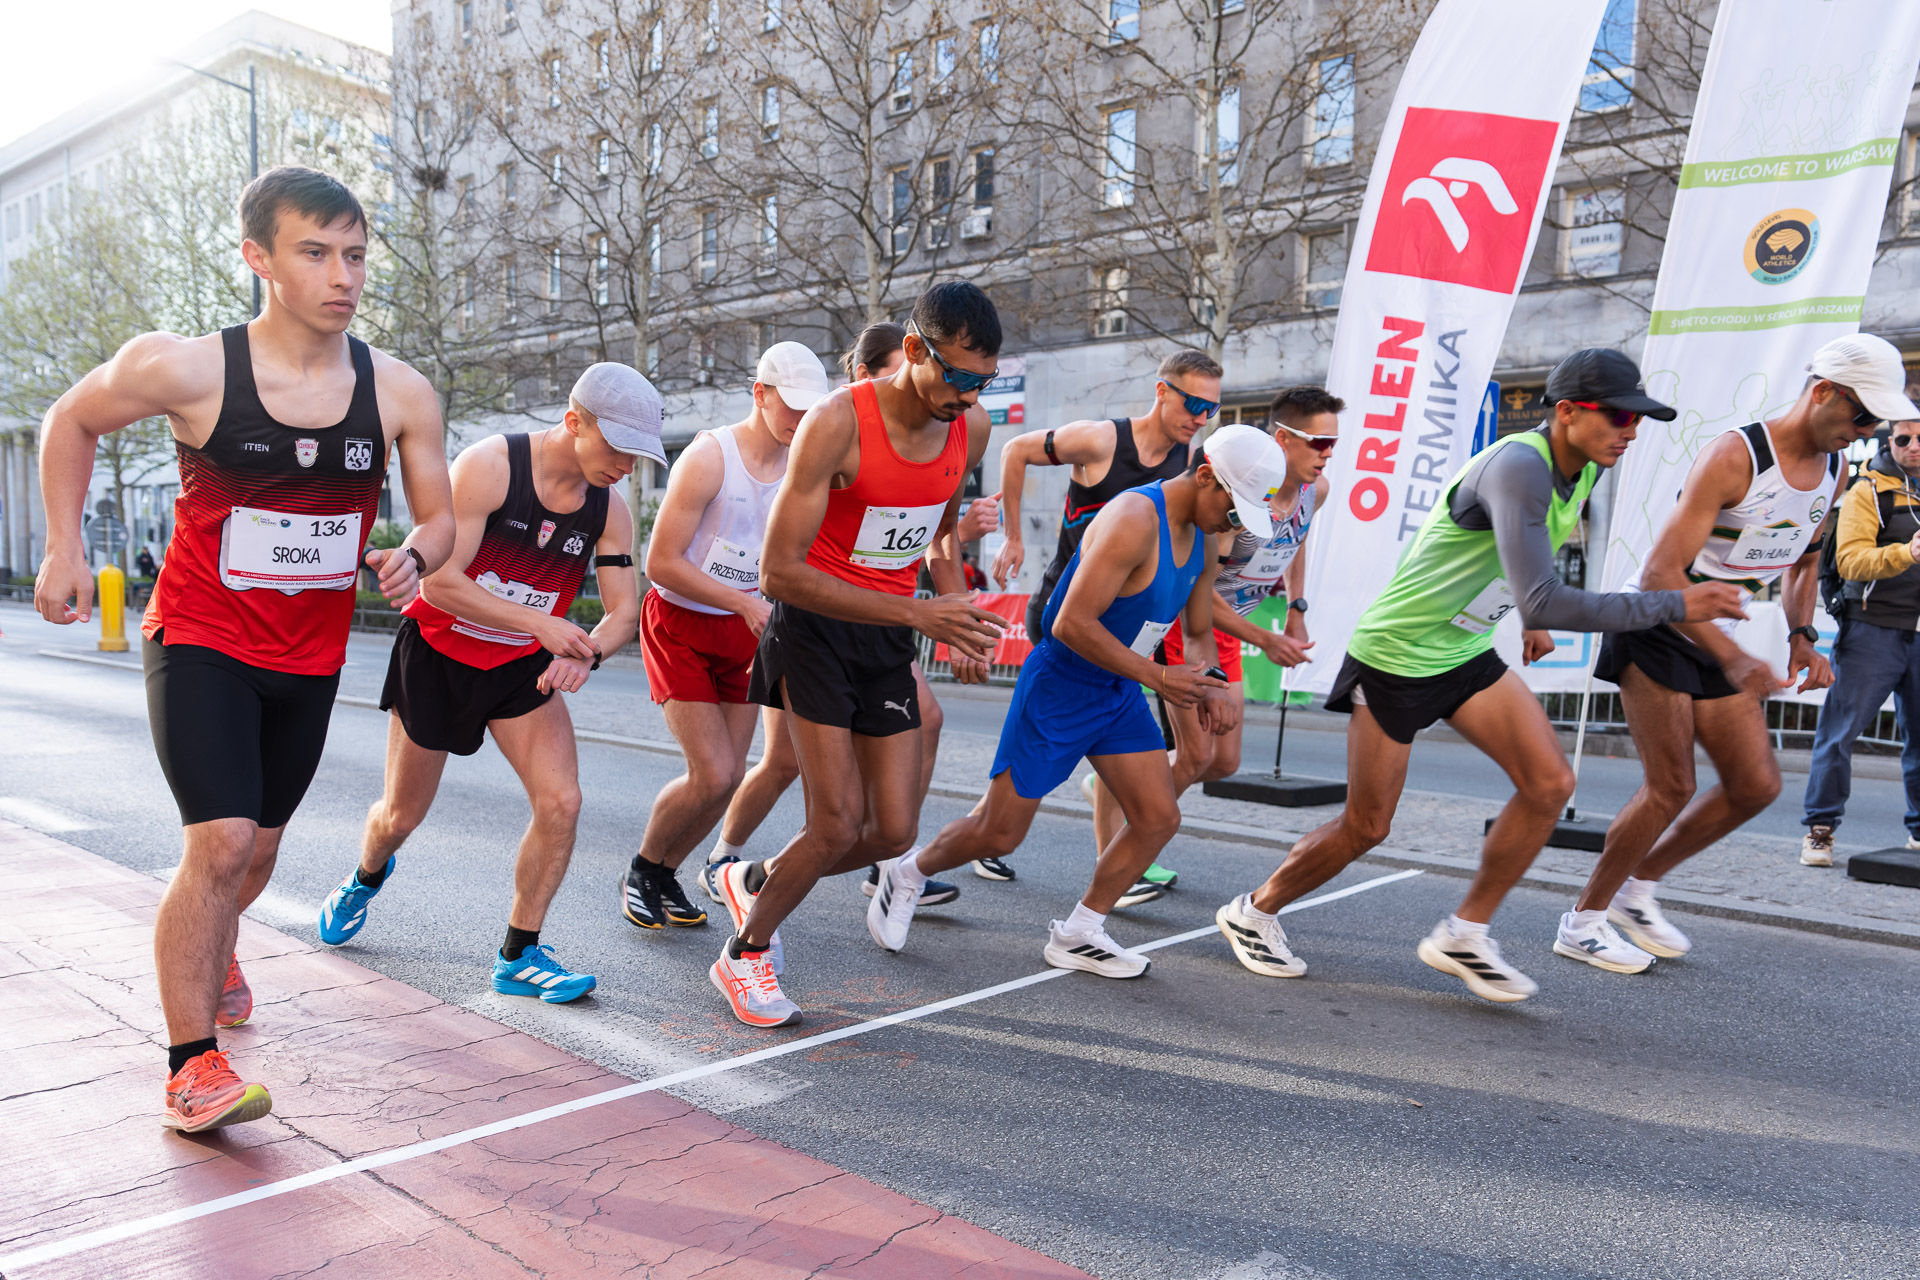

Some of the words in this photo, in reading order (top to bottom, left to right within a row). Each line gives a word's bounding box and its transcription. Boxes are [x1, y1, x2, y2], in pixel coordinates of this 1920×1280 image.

[1704, 162, 1790, 182] WELCOME
[1794, 160, 1819, 175] TO
[1825, 143, 1897, 172] WARSAW
[1763, 259, 1797, 267] ATHLETICS
[1710, 314, 1751, 325] CHODU
[1754, 313, 1766, 323] W
[1767, 309, 1798, 321] SERCU
[1798, 304, 1862, 315] WARSZAWY
[1349, 316, 1426, 522] ORLEN
[1397, 328, 1468, 542] TERMIKA
[310, 519, 347, 537] 136
[1790, 529, 1802, 541] 5
[882, 526, 927, 551] 162
[272, 546, 321, 564] SROKA
[522, 593, 550, 608] 123
